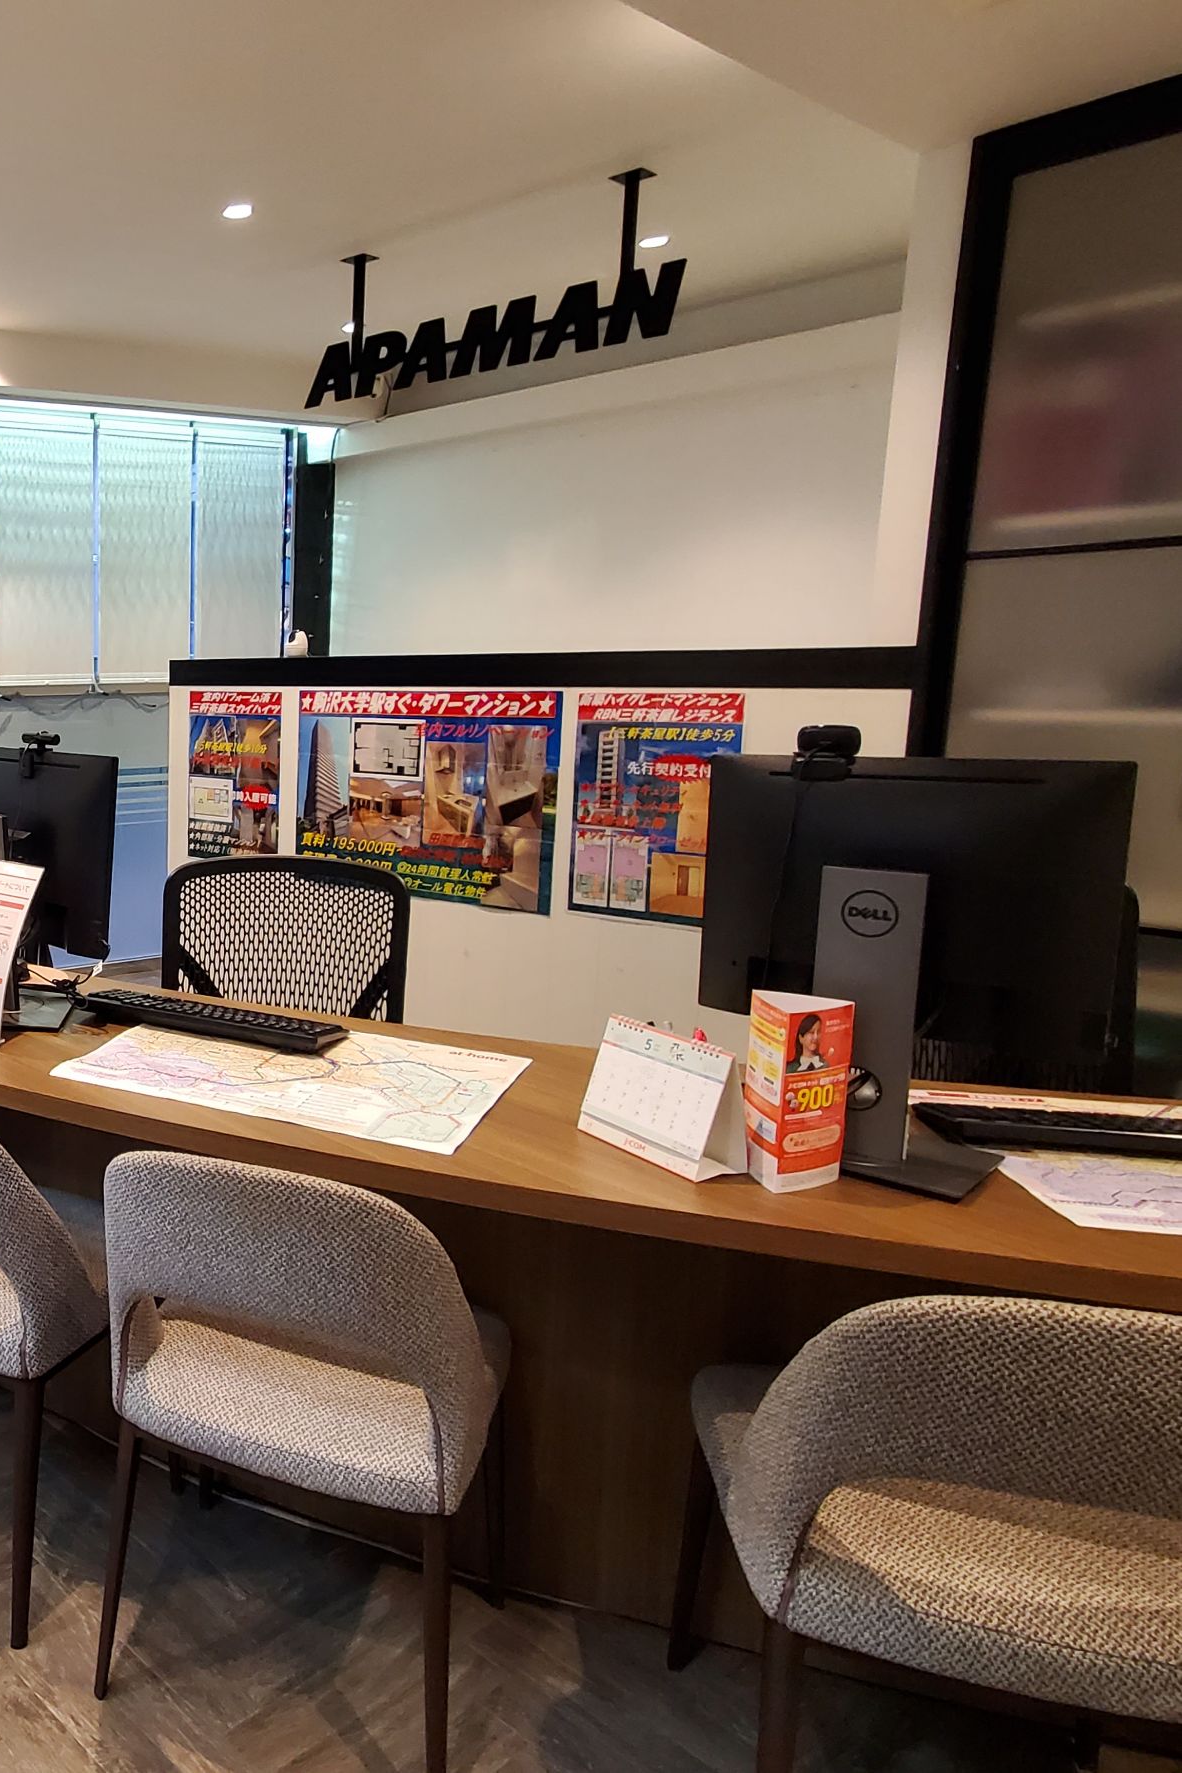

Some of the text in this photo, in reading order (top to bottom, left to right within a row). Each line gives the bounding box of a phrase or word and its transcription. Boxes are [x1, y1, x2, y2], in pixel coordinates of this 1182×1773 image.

[304, 258, 687, 409] APAMAN
[848, 906, 892, 921] DELL
[644, 1038, 654, 1051] 5
[798, 1084, 834, 1112] 900
